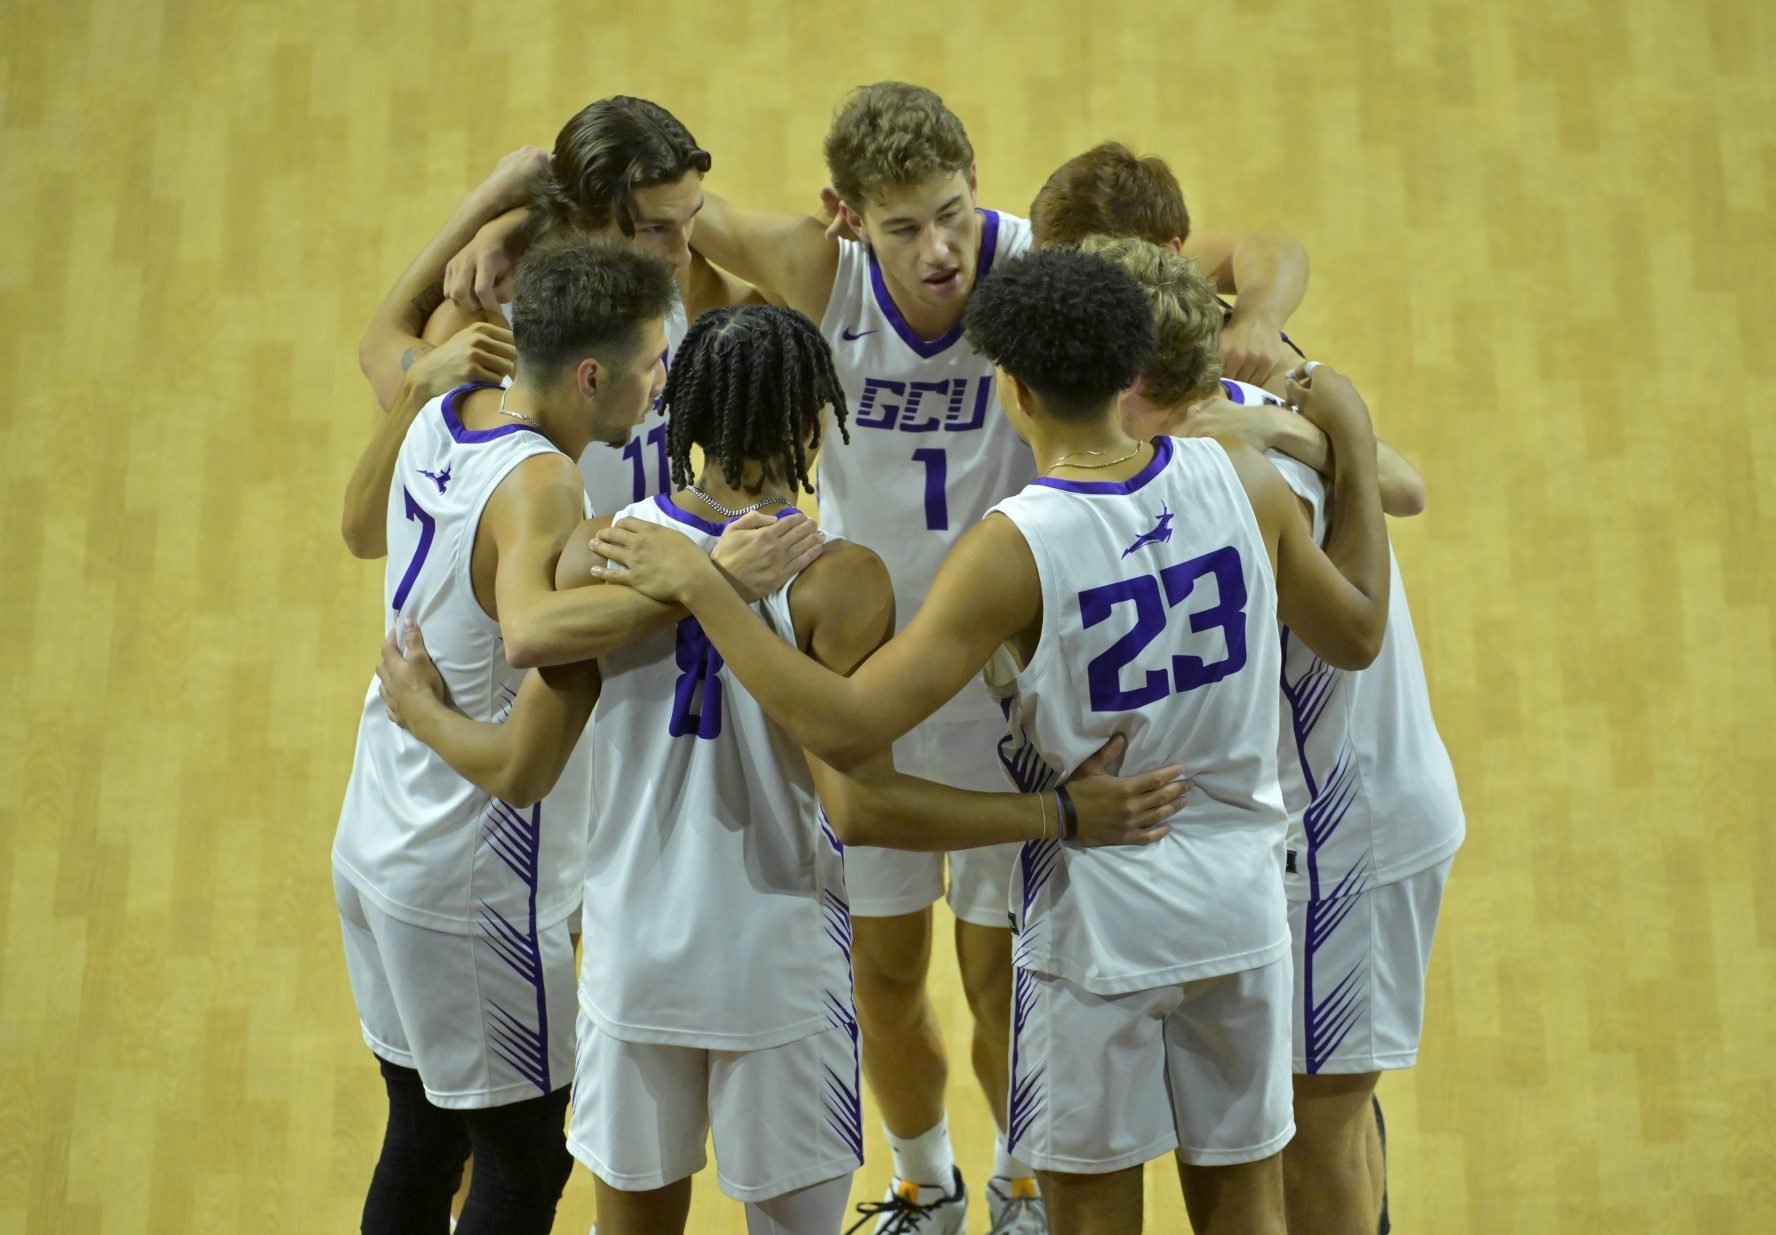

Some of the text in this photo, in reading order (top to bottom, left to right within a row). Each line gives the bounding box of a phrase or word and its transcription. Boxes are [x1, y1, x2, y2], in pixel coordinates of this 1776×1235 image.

[856, 375, 993, 432] GCU
[622, 422, 671, 503] 11
[911, 448, 948, 530] 1
[392, 484, 436, 616] 7
[1078, 546, 1247, 712] 23
